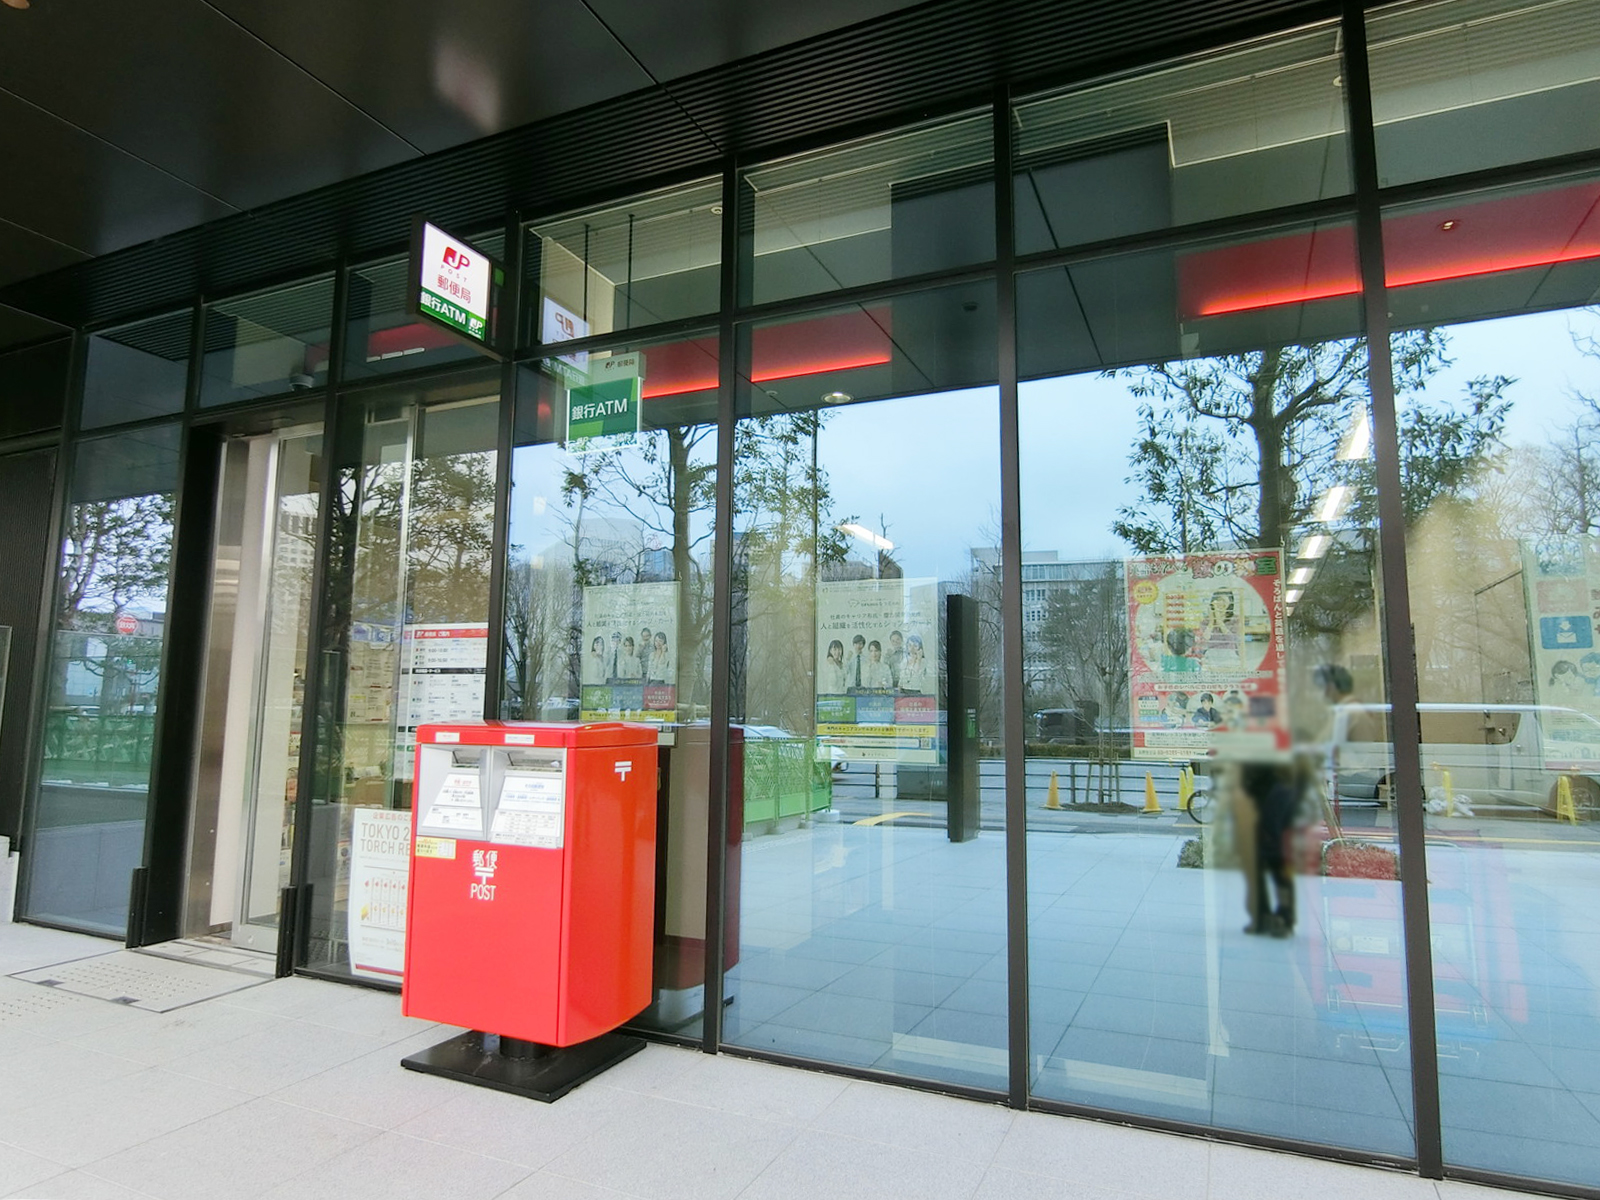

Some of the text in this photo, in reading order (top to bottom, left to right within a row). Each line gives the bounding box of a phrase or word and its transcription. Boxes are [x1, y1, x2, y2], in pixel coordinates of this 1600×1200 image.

[437, 274, 471, 304] 郵便局
[421, 291, 467, 325] 銀行ATM
[571, 398, 628, 421] 銀行ATM
[362, 823, 399, 841] TOKYO
[361, 839, 395, 854] TORCH
[472, 849, 498, 869] 郵便
[470, 883, 497, 901] POST
